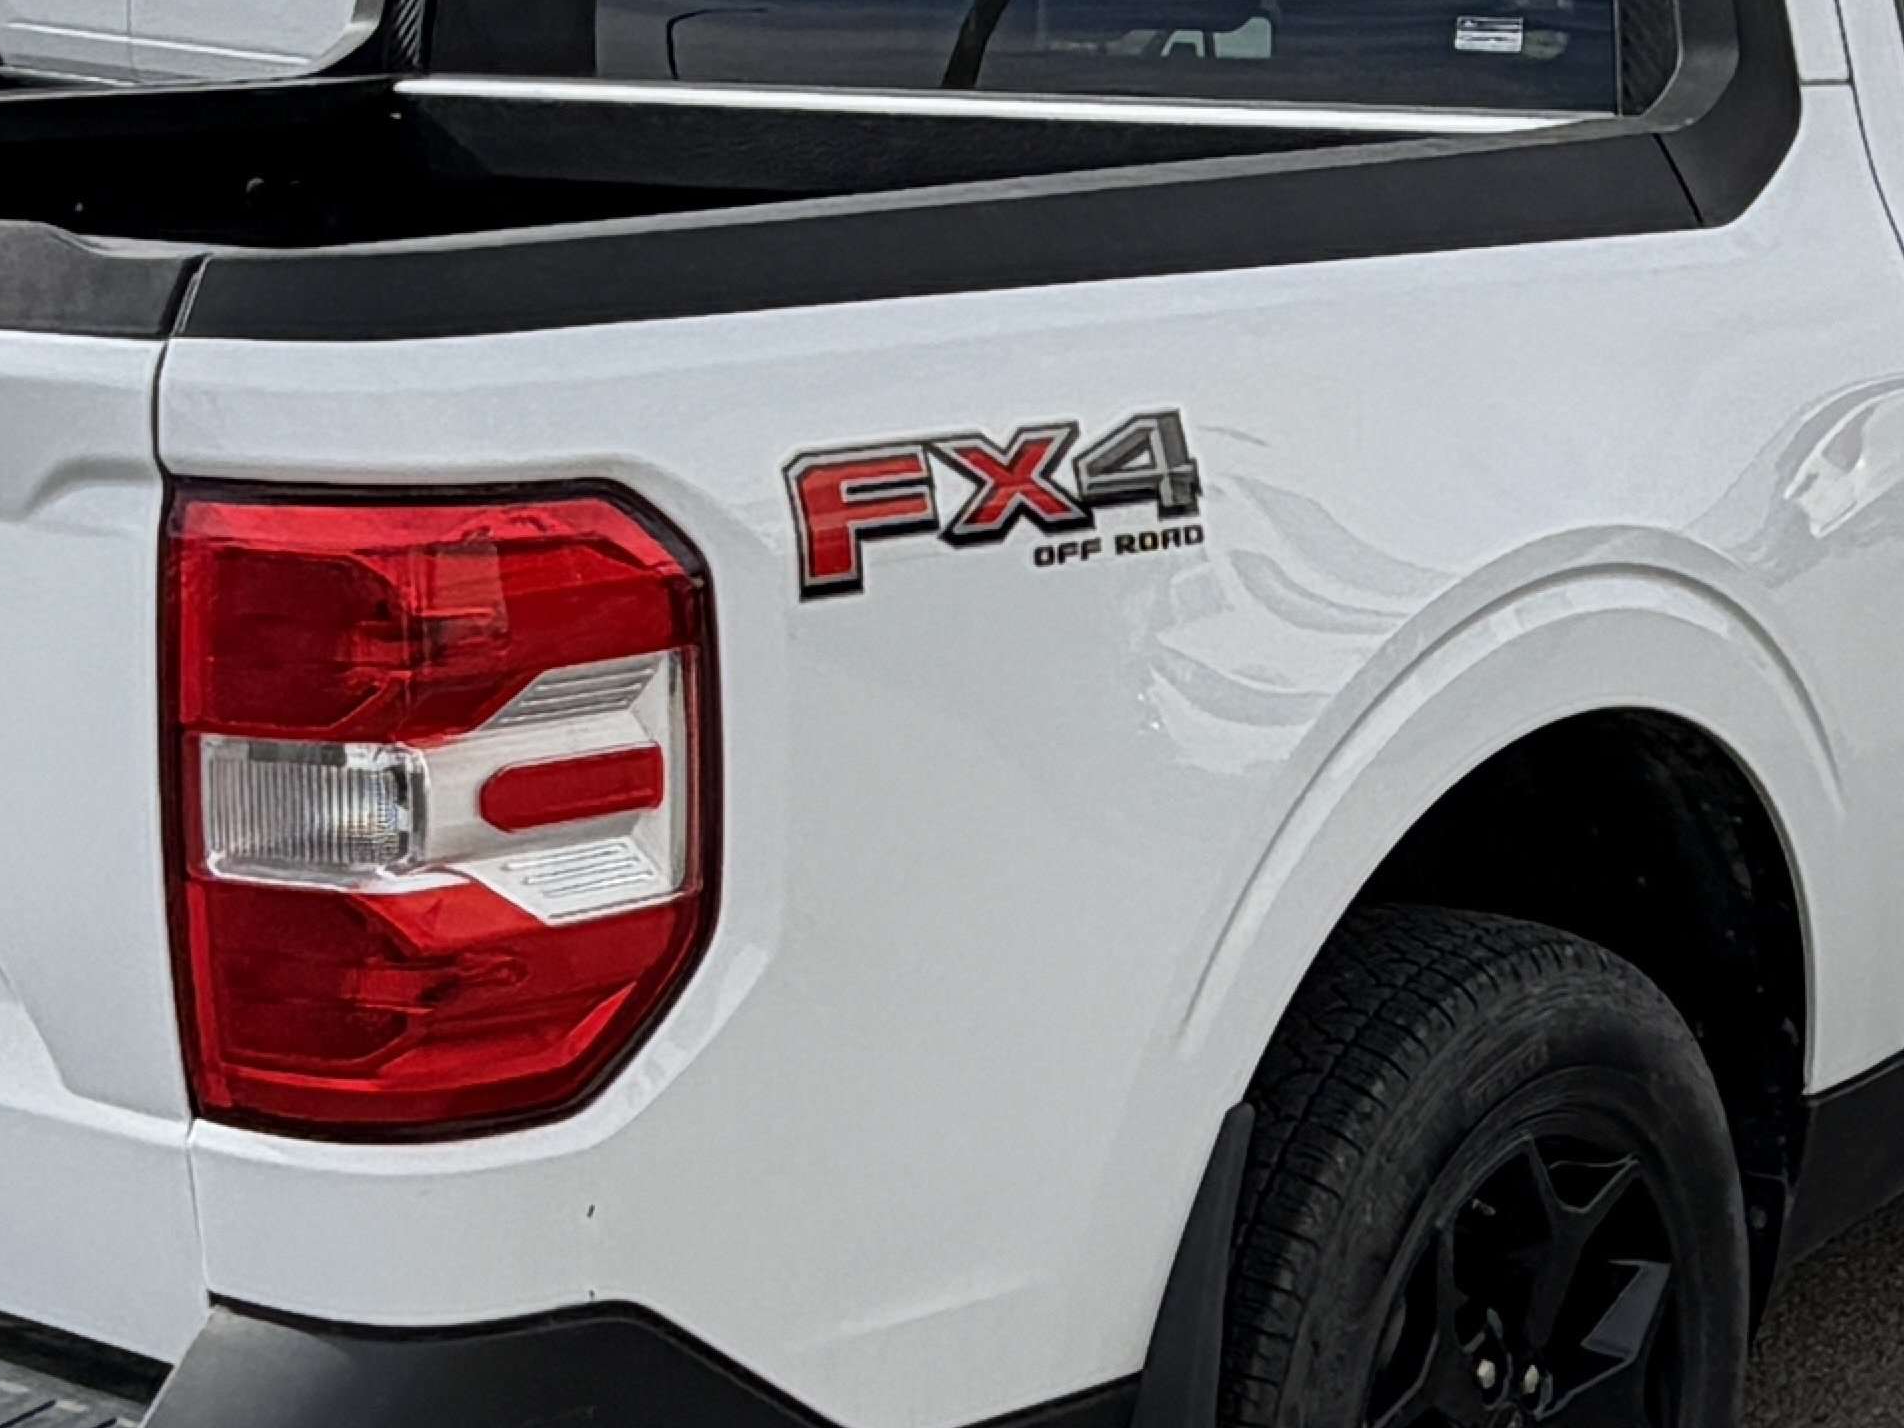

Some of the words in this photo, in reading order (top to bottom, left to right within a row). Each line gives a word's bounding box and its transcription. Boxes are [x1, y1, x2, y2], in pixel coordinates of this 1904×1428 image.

[782, 408, 1203, 603] FX4
[1033, 542, 1101, 567] OFF
[1114, 524, 1205, 556] ROAD
